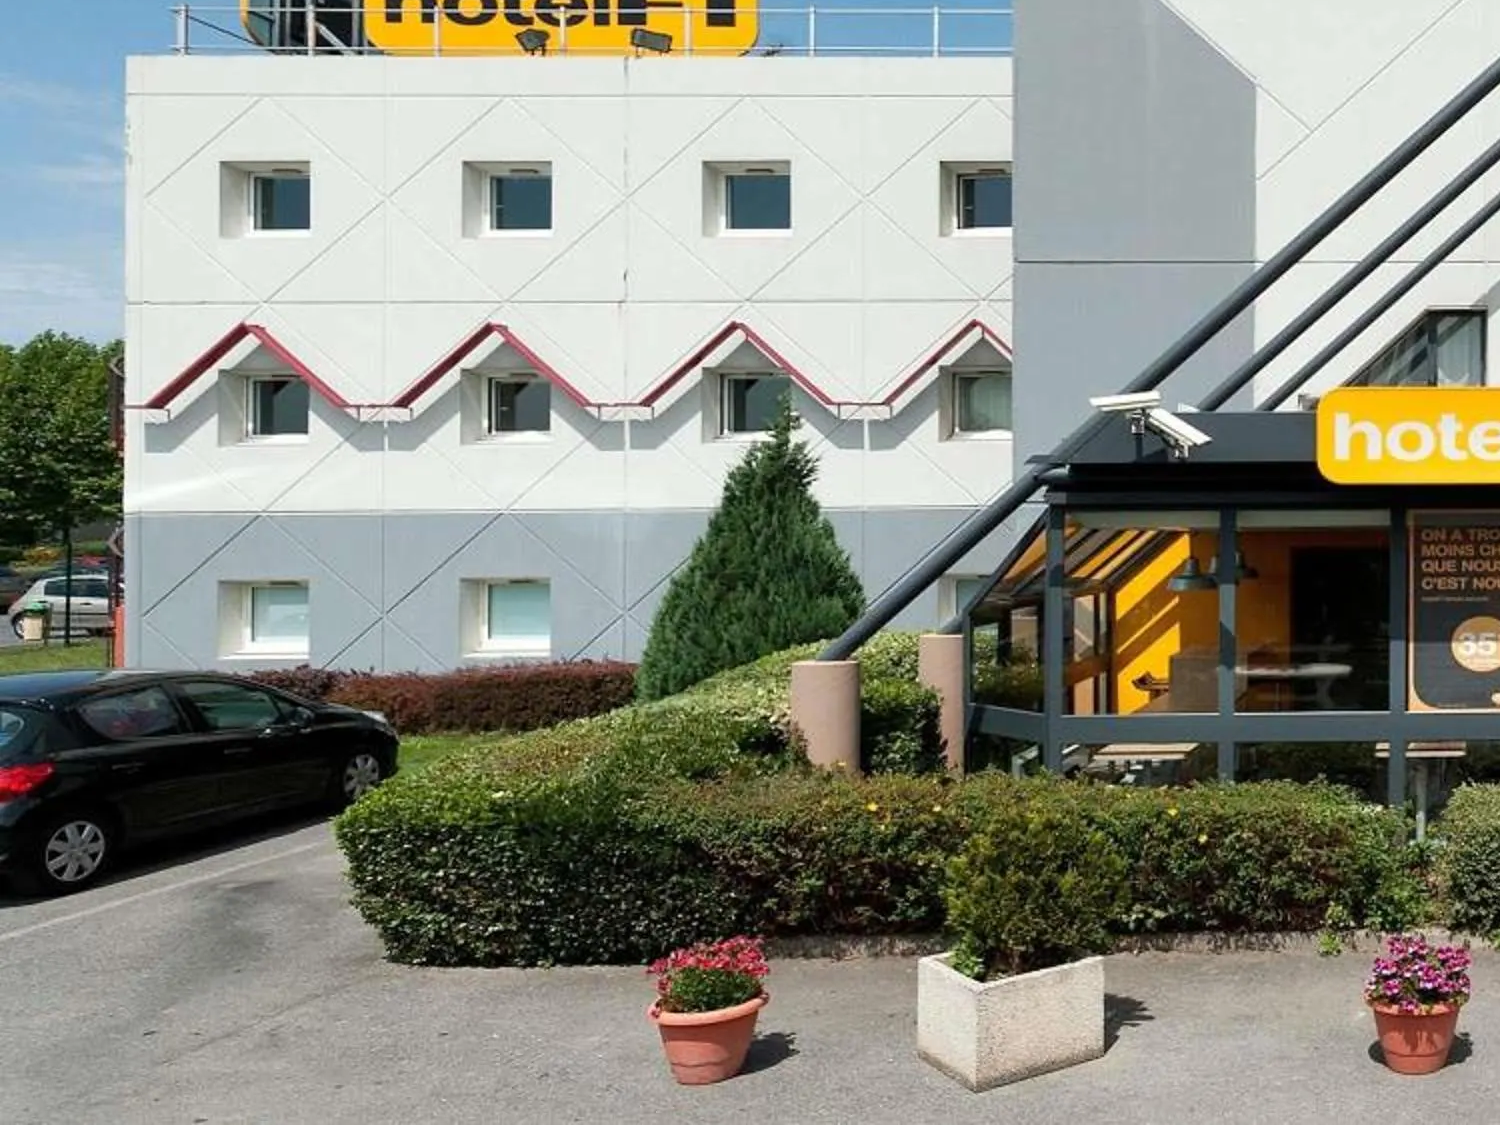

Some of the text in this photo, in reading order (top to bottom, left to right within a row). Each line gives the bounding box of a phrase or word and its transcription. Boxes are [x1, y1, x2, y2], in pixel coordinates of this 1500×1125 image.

[1421, 528, 1447, 541] ON
[1450, 528, 1463, 541] A
[1421, 544, 1475, 557] MOINS
[1421, 559, 1457, 573] QUE
[1421, 577, 1468, 590] C'EST
